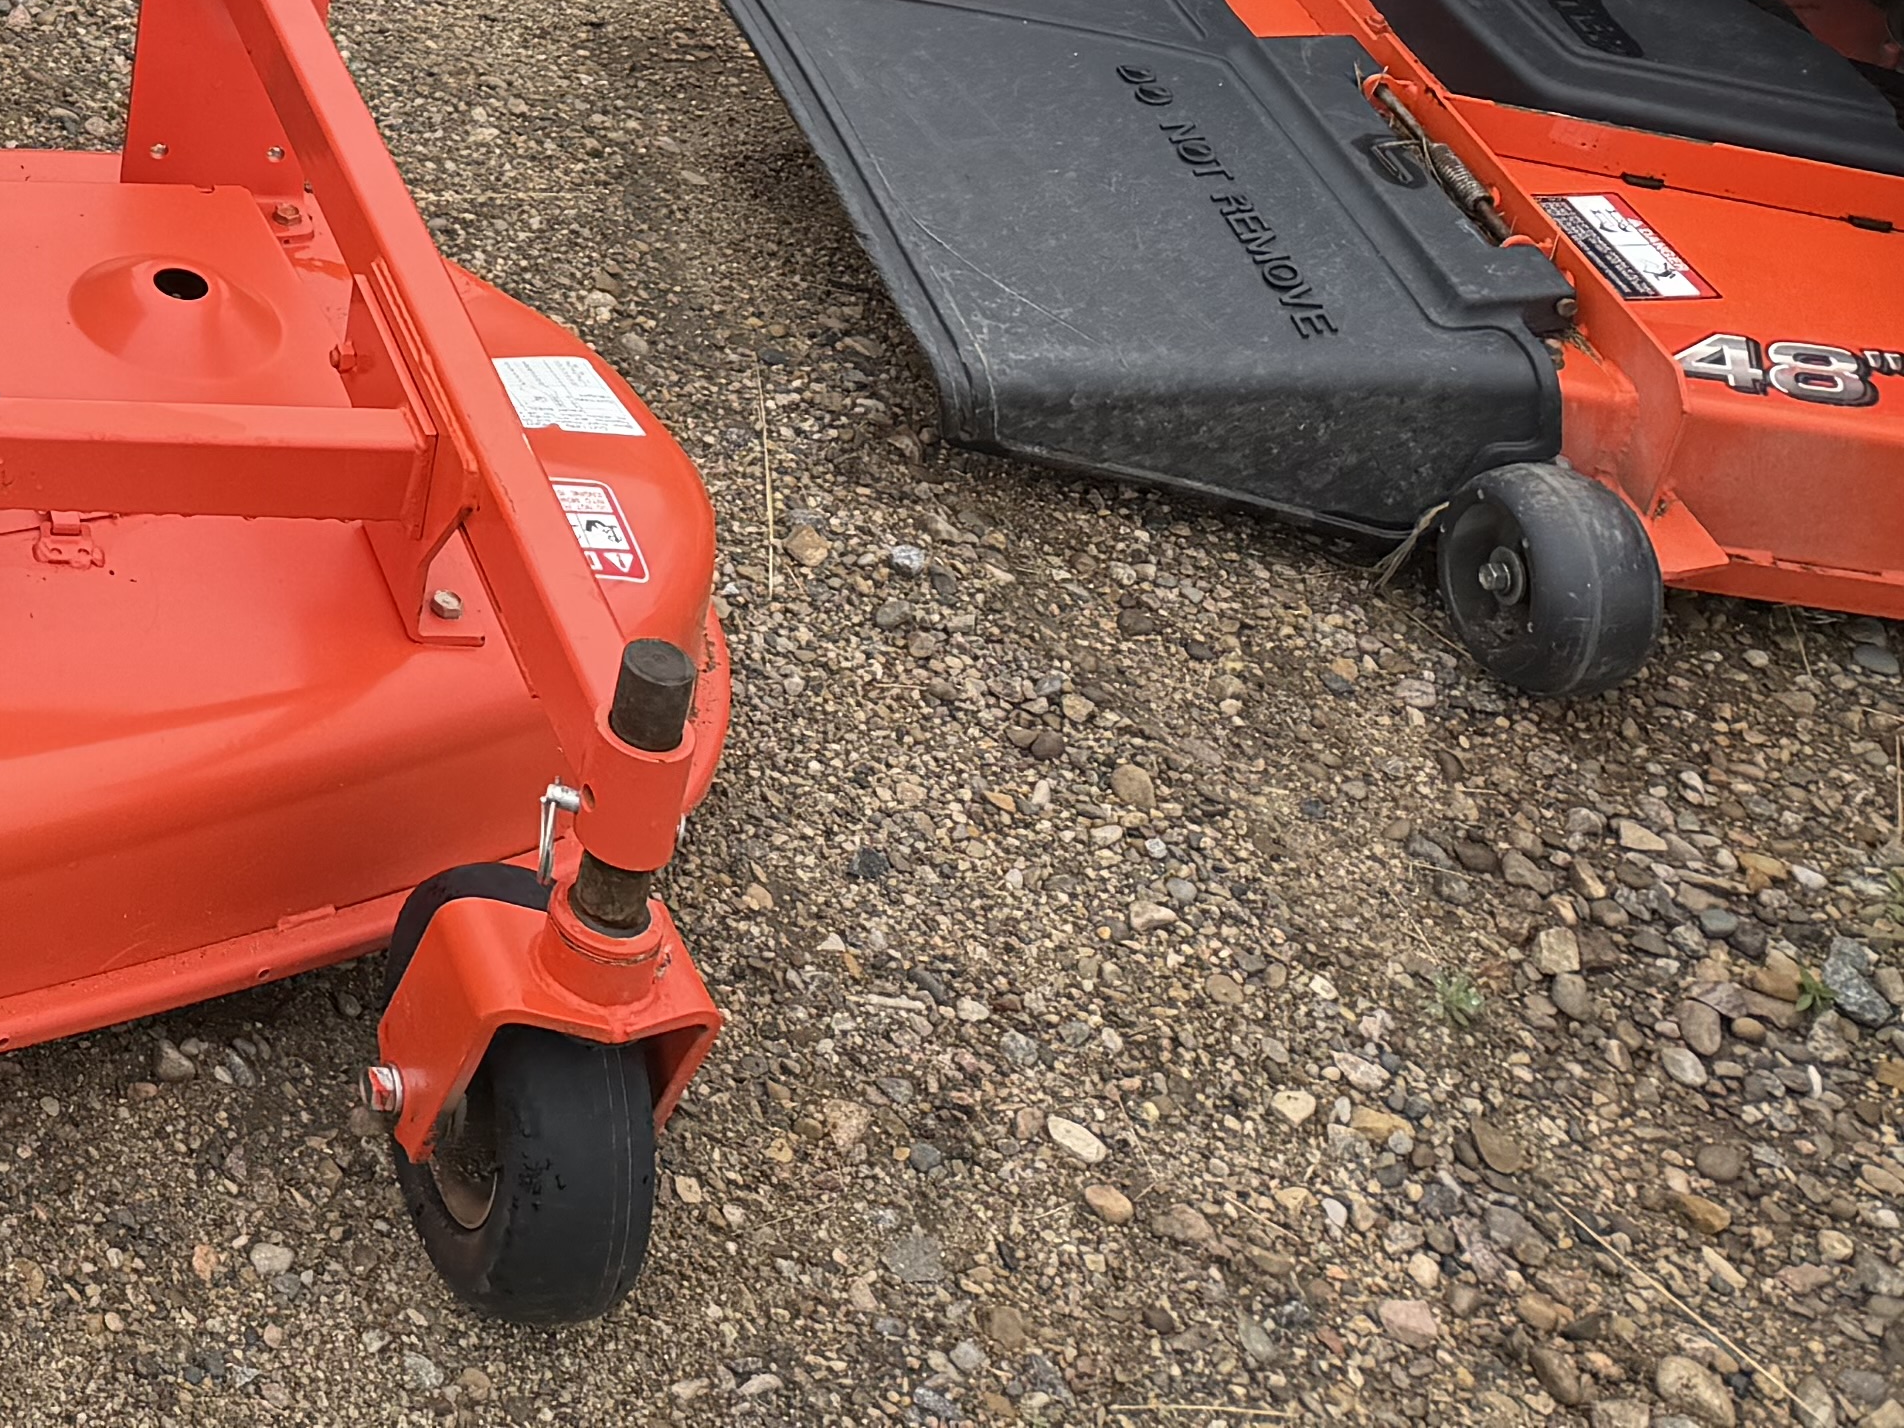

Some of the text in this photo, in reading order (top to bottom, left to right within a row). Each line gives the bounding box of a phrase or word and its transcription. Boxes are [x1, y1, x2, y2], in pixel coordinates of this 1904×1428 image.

[1116, 64, 1340, 340] DO NOT REMOVE
